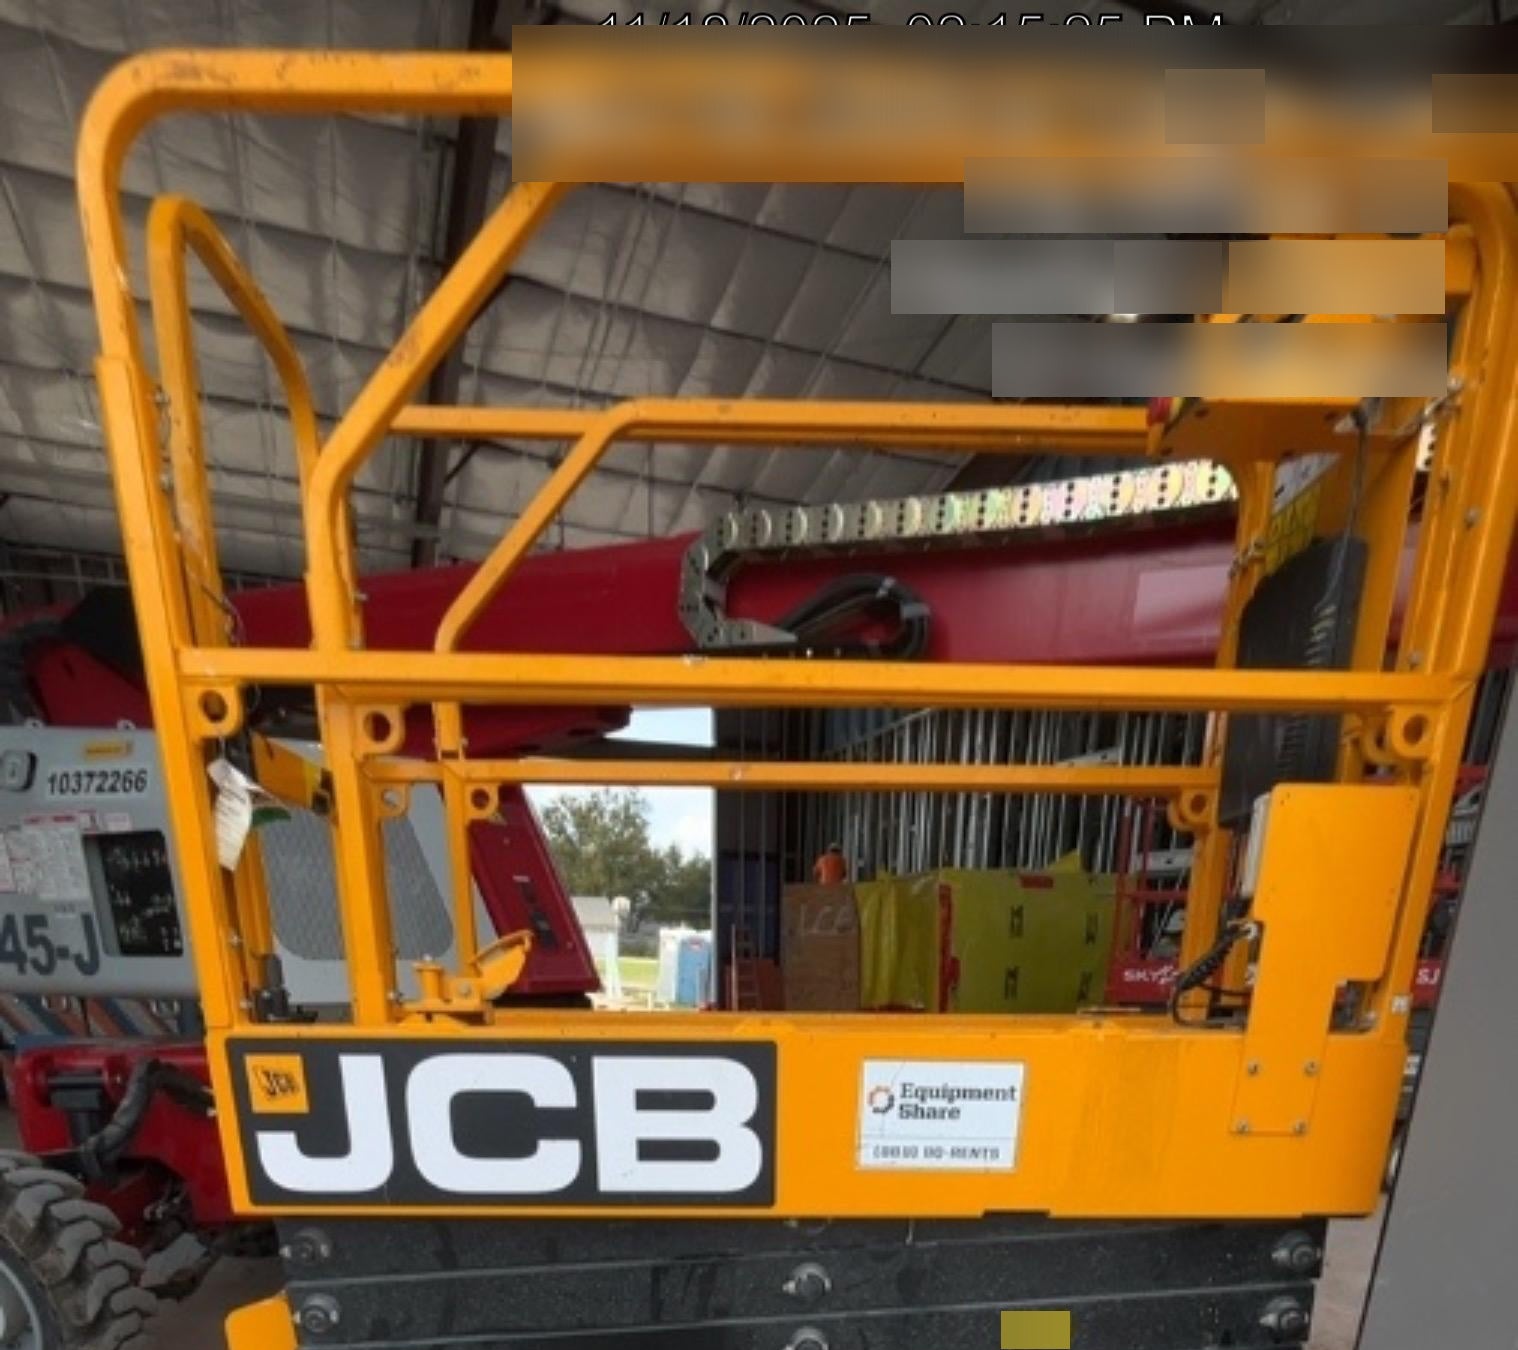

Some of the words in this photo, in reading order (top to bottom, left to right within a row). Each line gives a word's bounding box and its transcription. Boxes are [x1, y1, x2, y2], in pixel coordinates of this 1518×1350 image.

[48, 770, 148, 795] 10372266
[899, 1082, 1017, 1104] Equipment
[255, 1053, 763, 1194] JCB
[899, 1104, 961, 1120] Share
